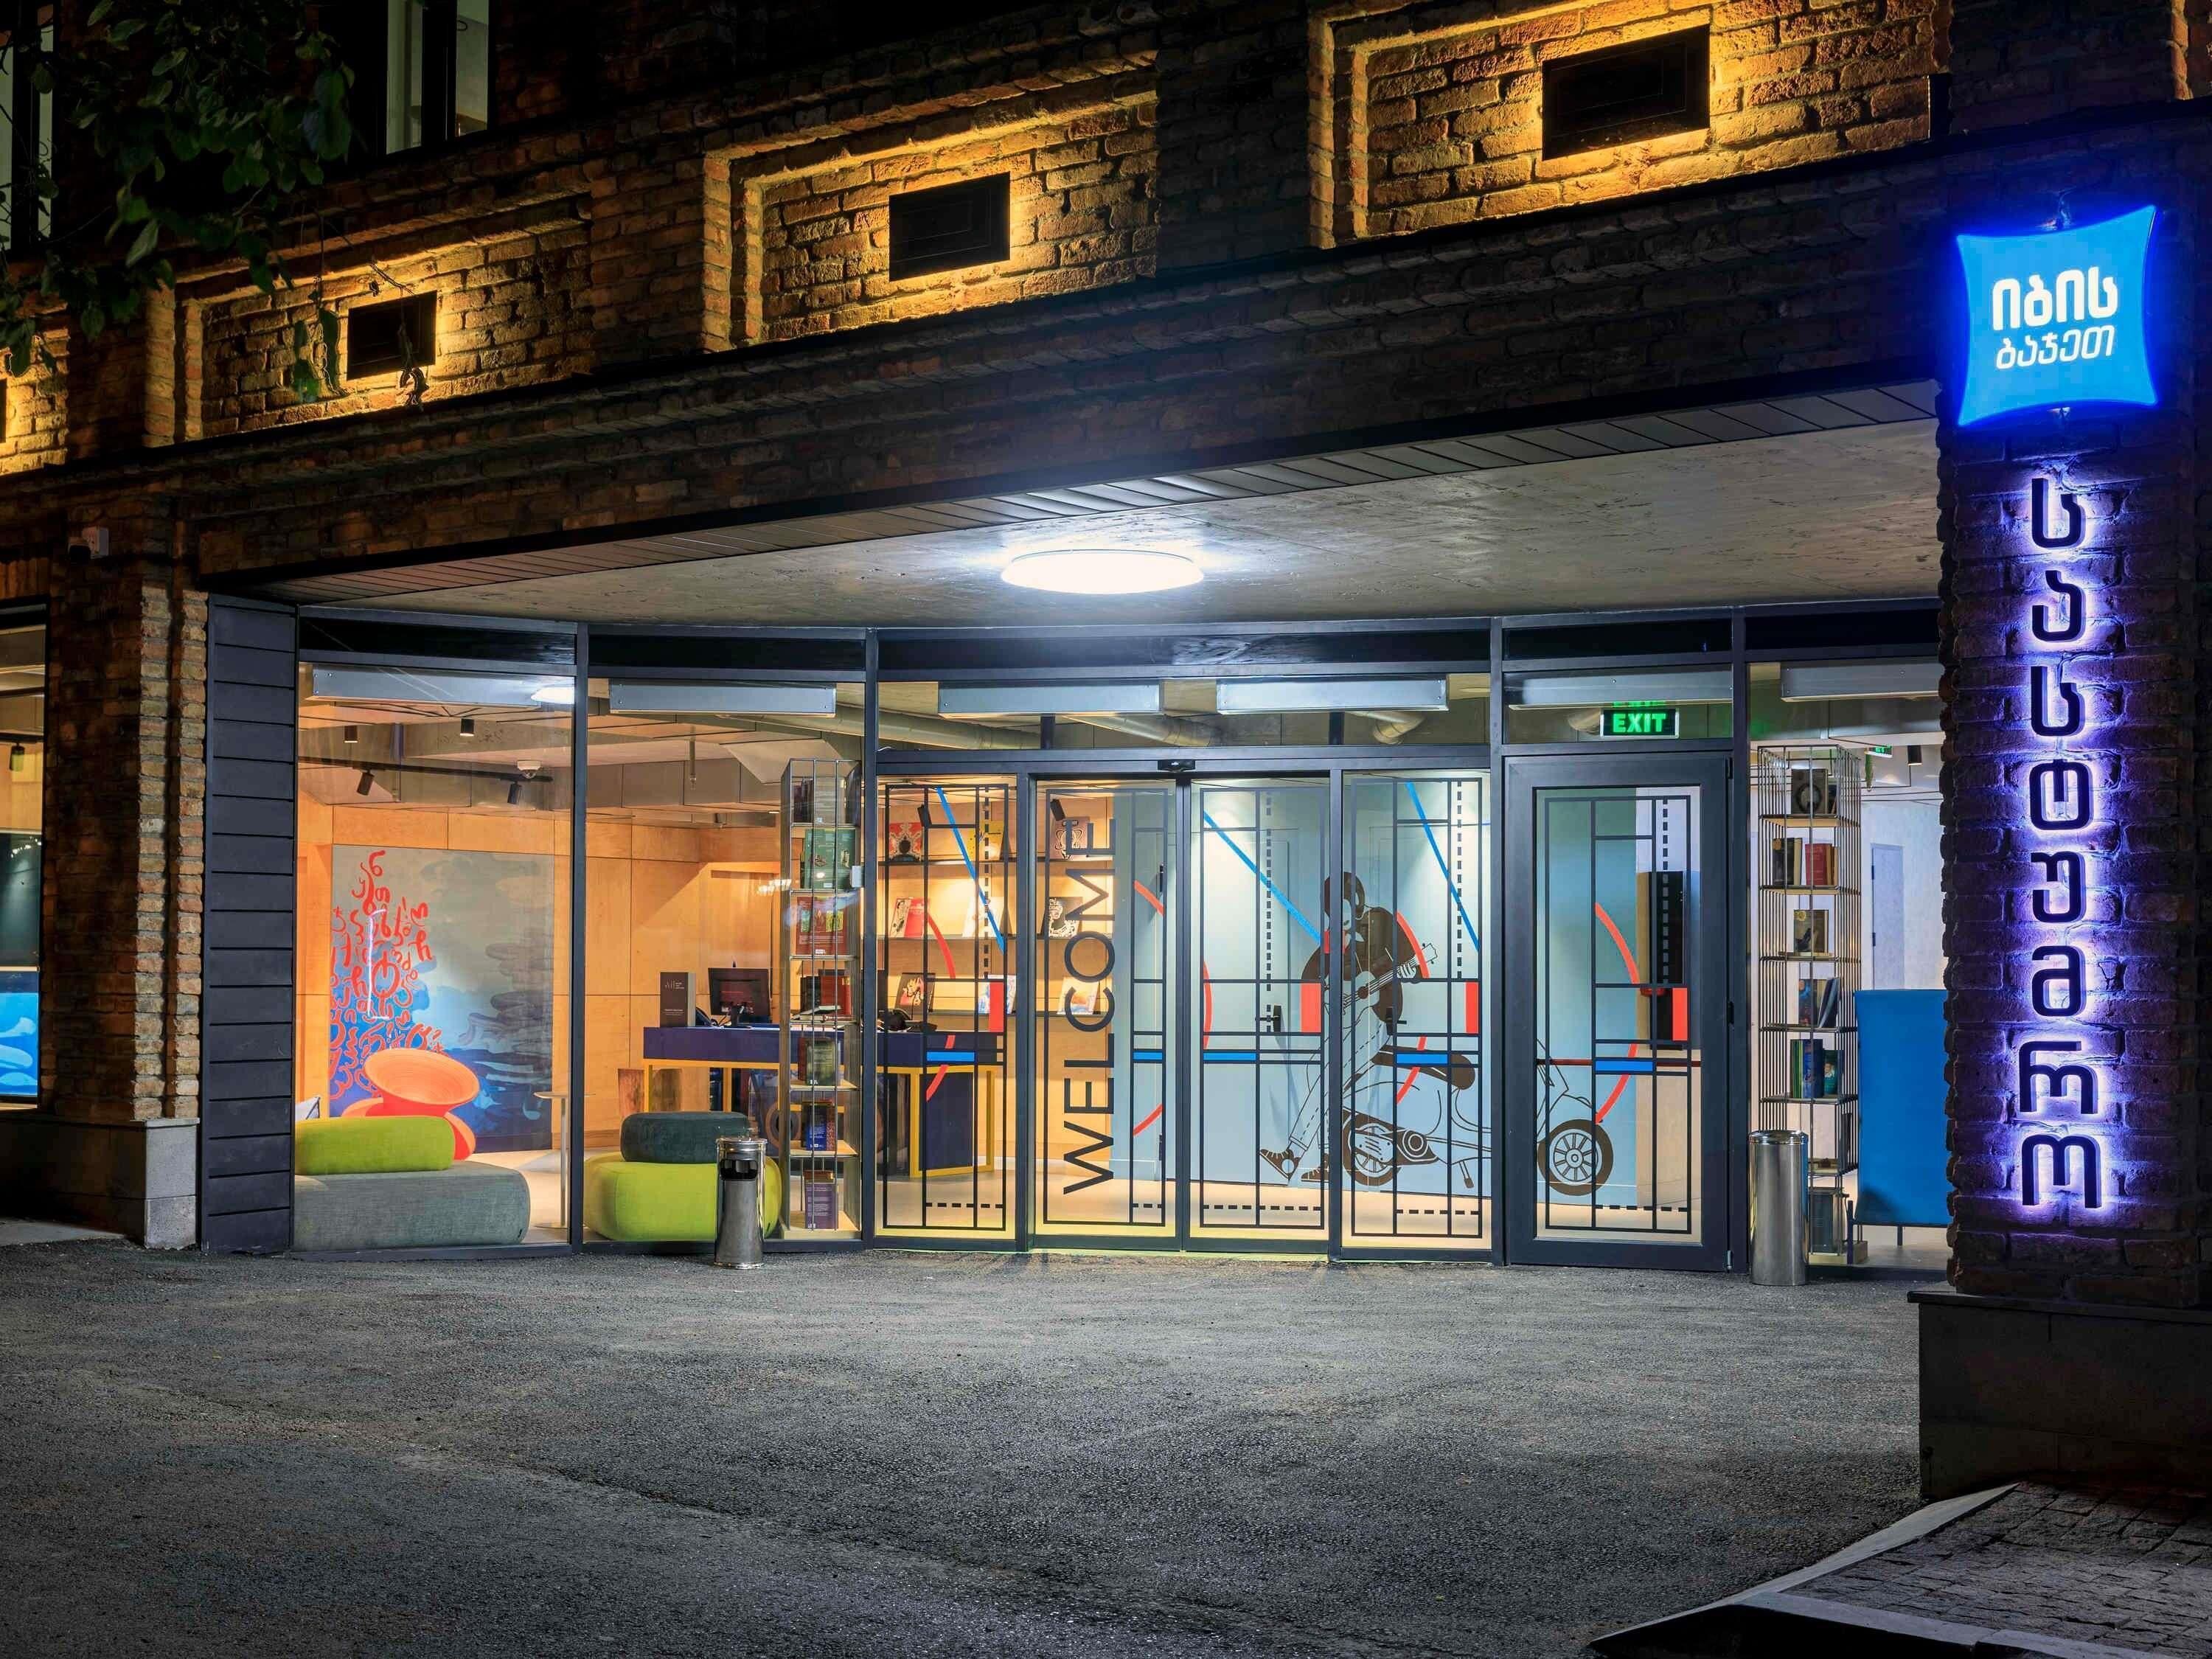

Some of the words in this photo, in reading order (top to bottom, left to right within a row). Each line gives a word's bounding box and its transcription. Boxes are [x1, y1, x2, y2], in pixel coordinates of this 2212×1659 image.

[1992, 266, 2118, 331] იბის
[1996, 324, 2115, 369] ბაჯეთ
[1613, 713, 1666, 733] EXIT
[2019, 478, 2101, 1208] სასტუმრო
[1063, 818, 1116, 1194] WELCOME
